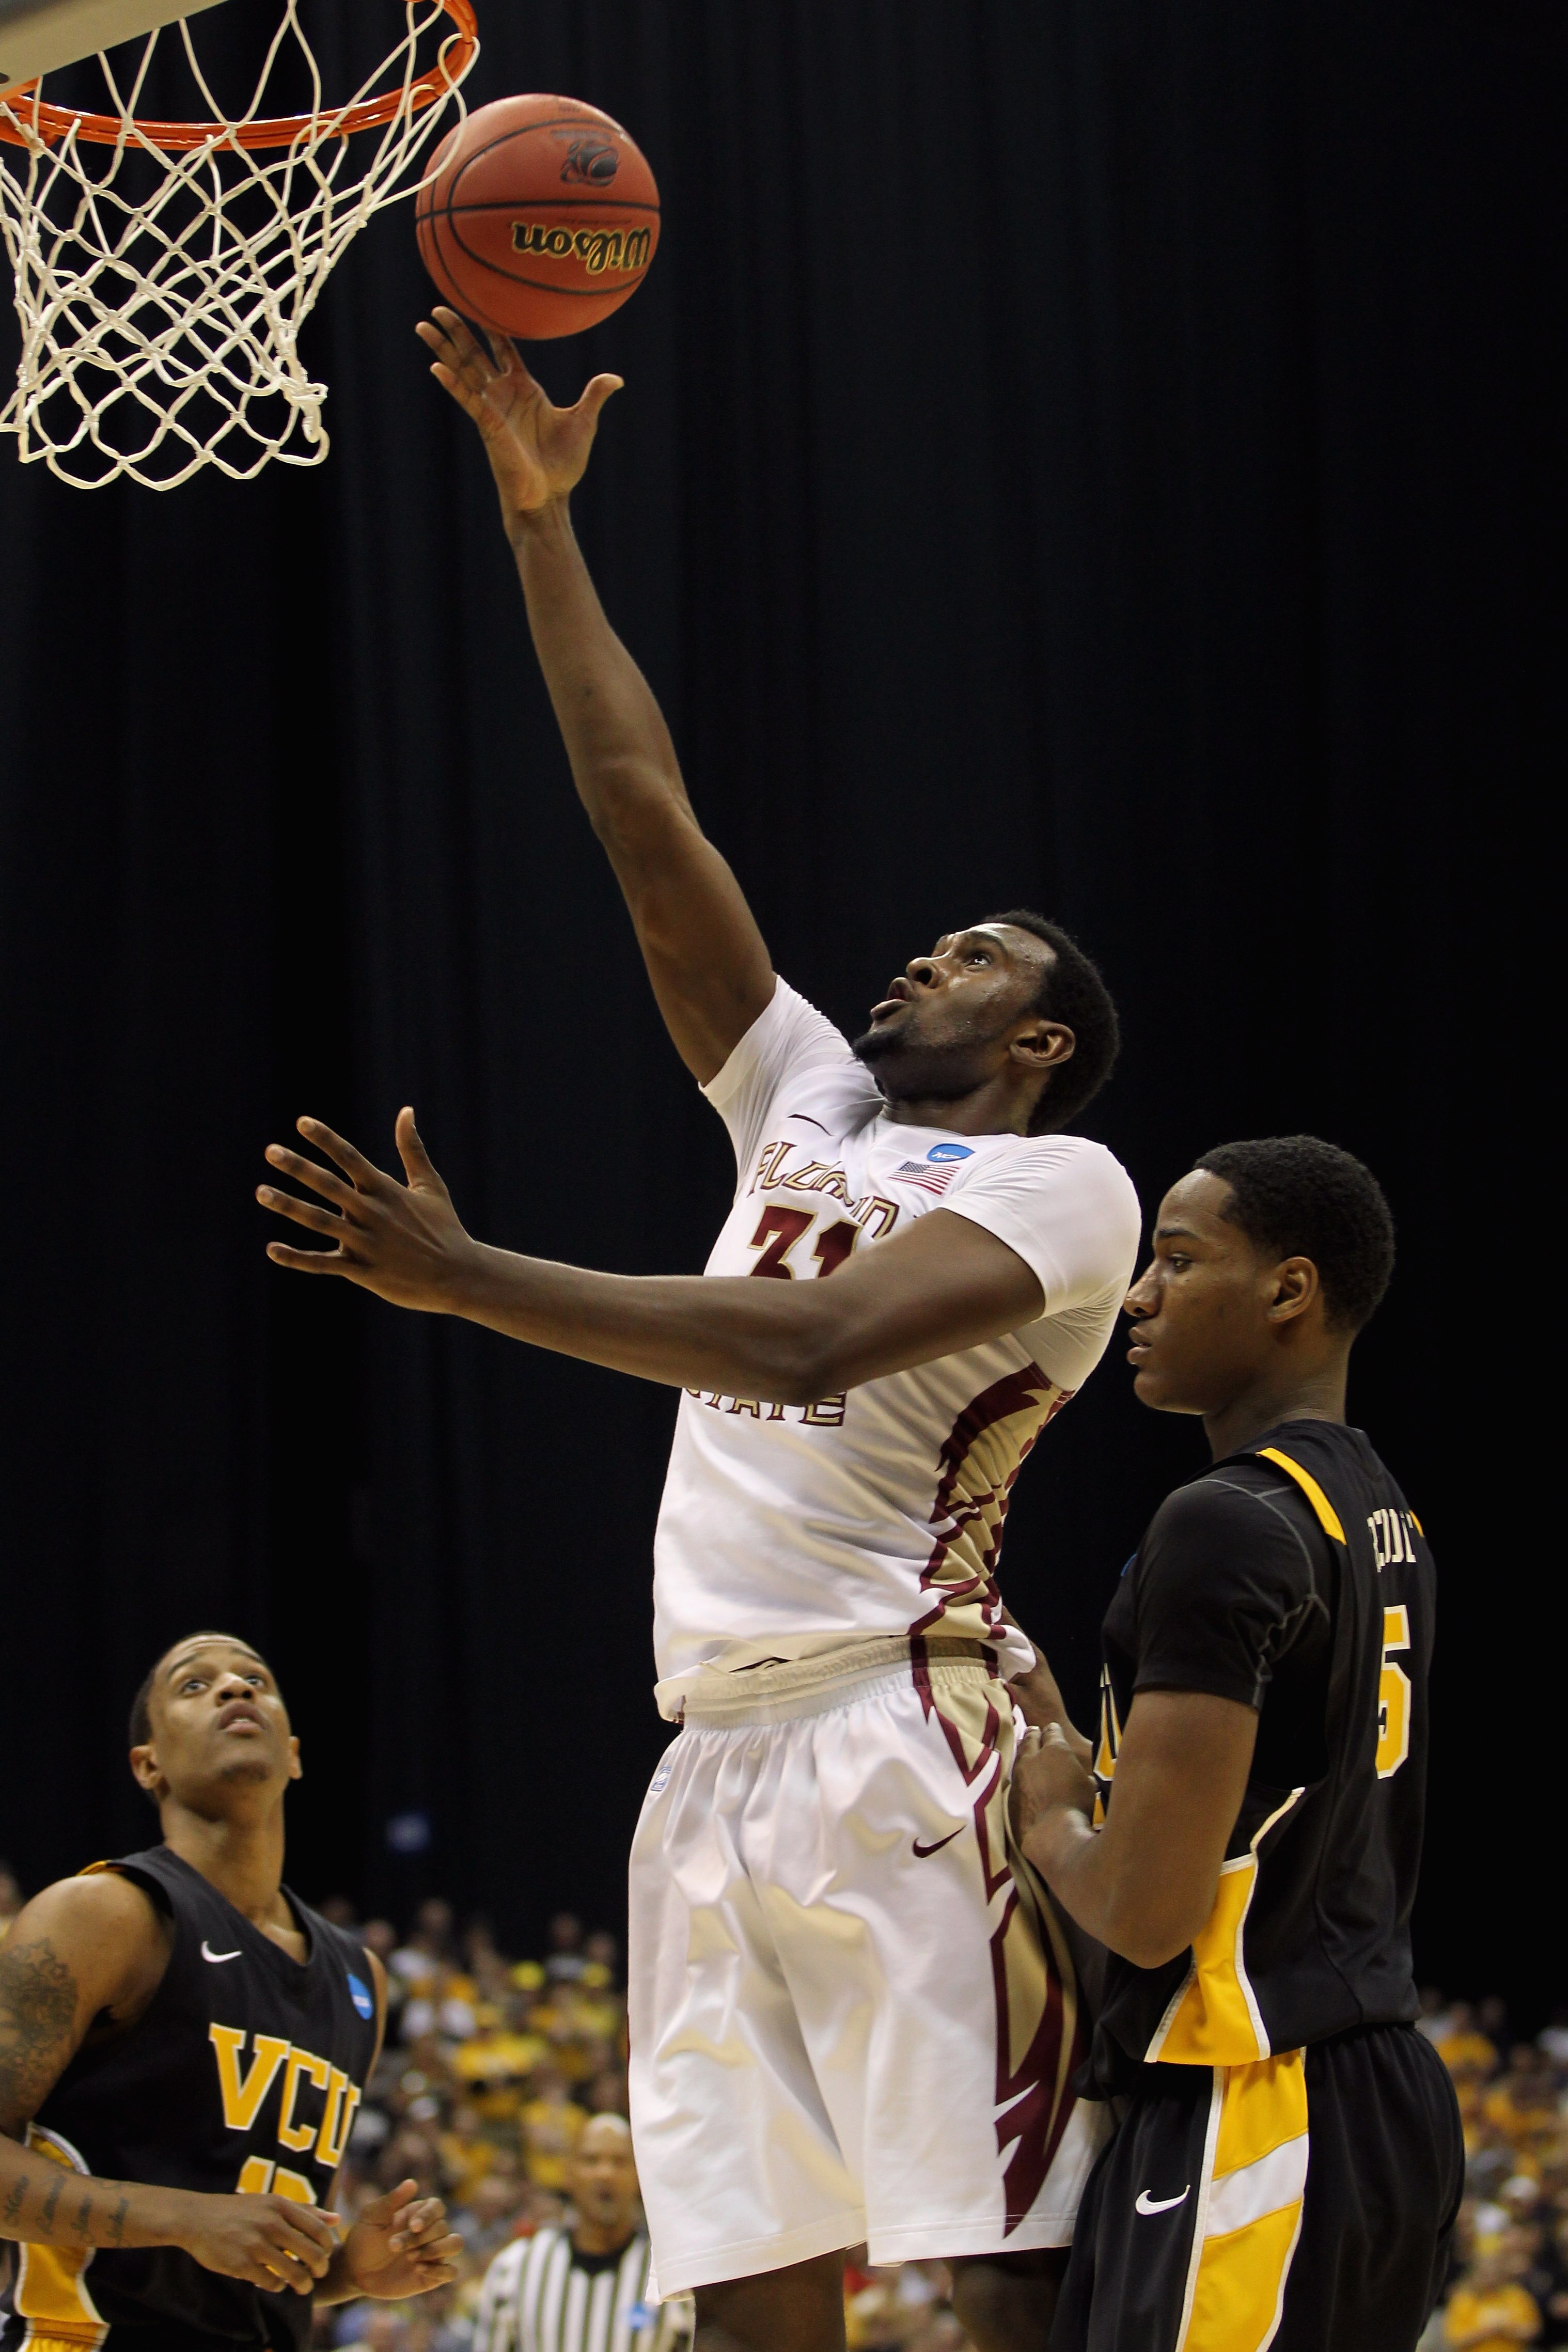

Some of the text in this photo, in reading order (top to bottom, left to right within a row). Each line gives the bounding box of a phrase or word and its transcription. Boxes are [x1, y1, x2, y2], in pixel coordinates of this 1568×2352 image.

[511, 222, 651, 275] Wilson
[746, 1141, 916, 1239] FLORID
[1375, 1605, 1412, 1780] 5
[209, 2021, 361, 2168] VCU
